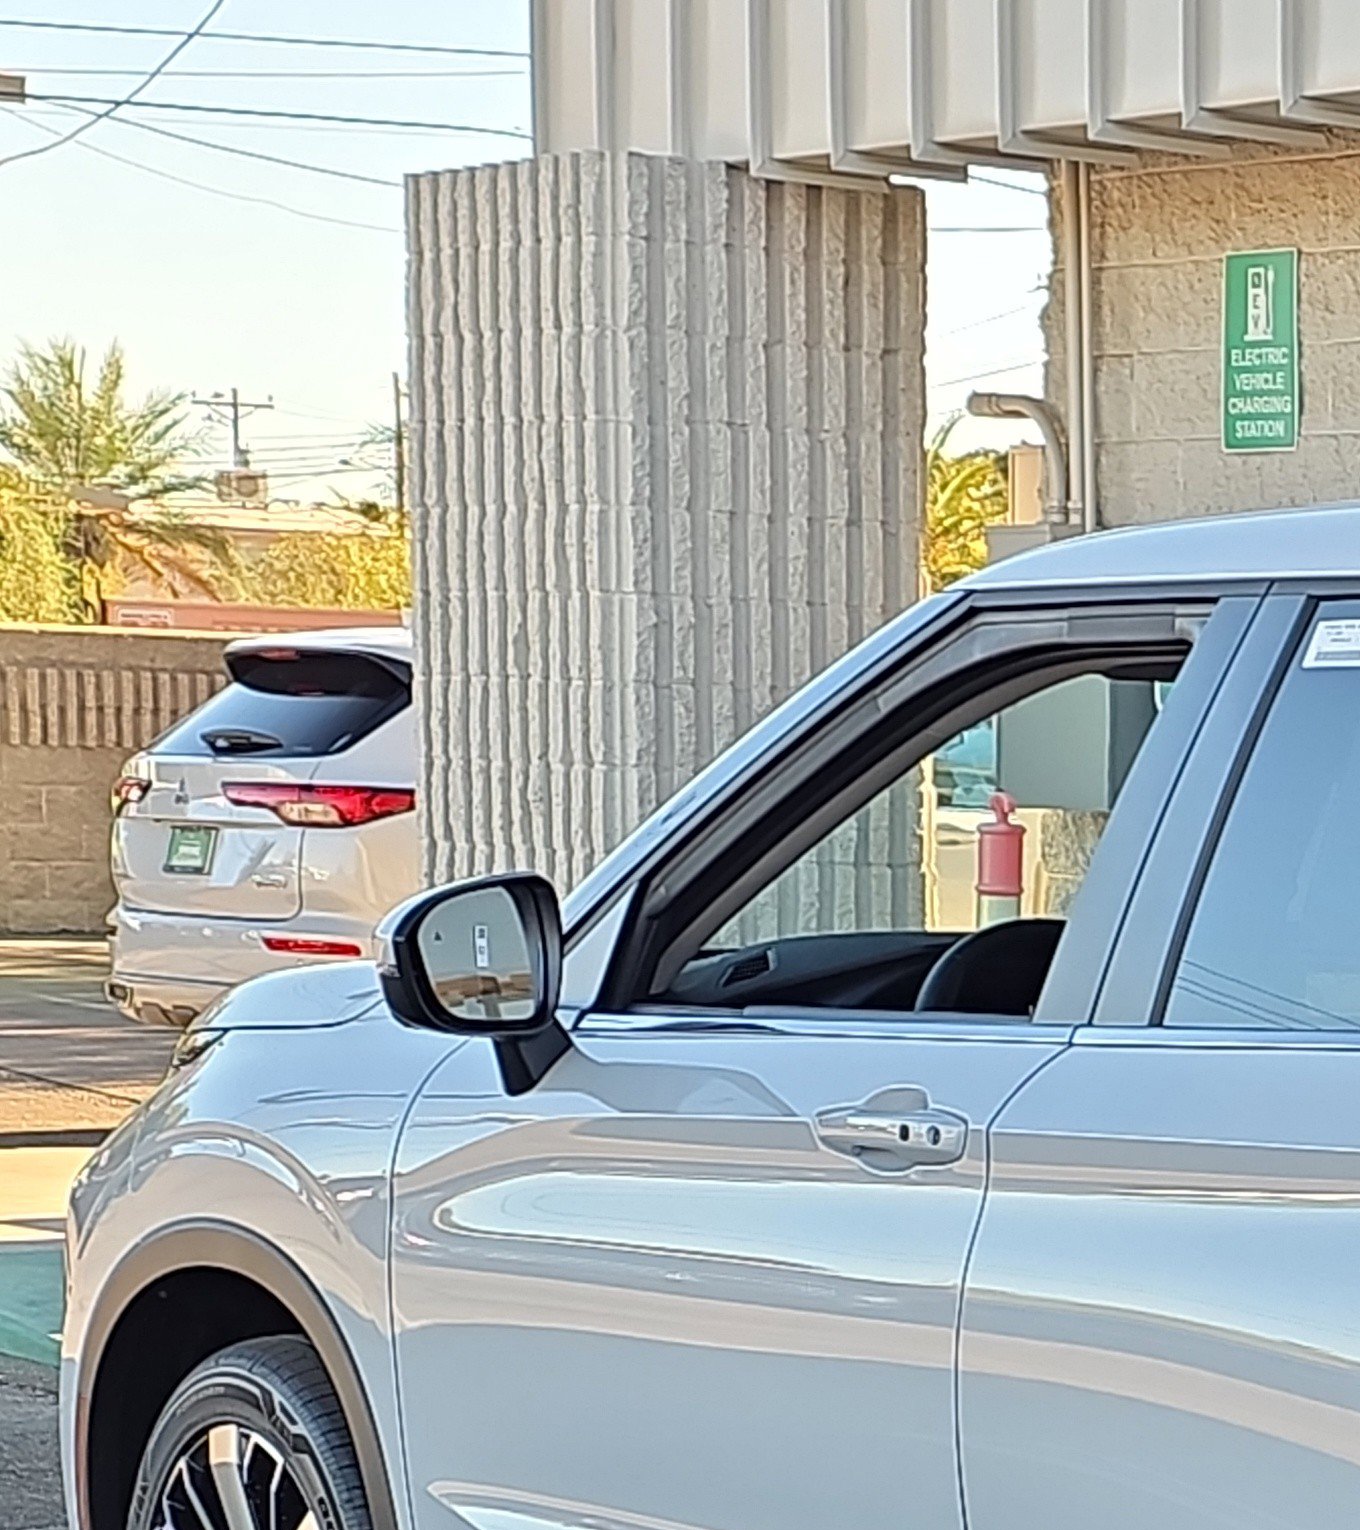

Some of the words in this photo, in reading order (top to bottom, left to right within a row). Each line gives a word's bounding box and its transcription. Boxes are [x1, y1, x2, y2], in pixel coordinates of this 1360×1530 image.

[1231, 347, 1289, 366] ELECTRIC
[1233, 372, 1285, 390] VEHICLE
[1228, 396, 1292, 414] CHARGING
[1235, 420, 1285, 438] STATION
